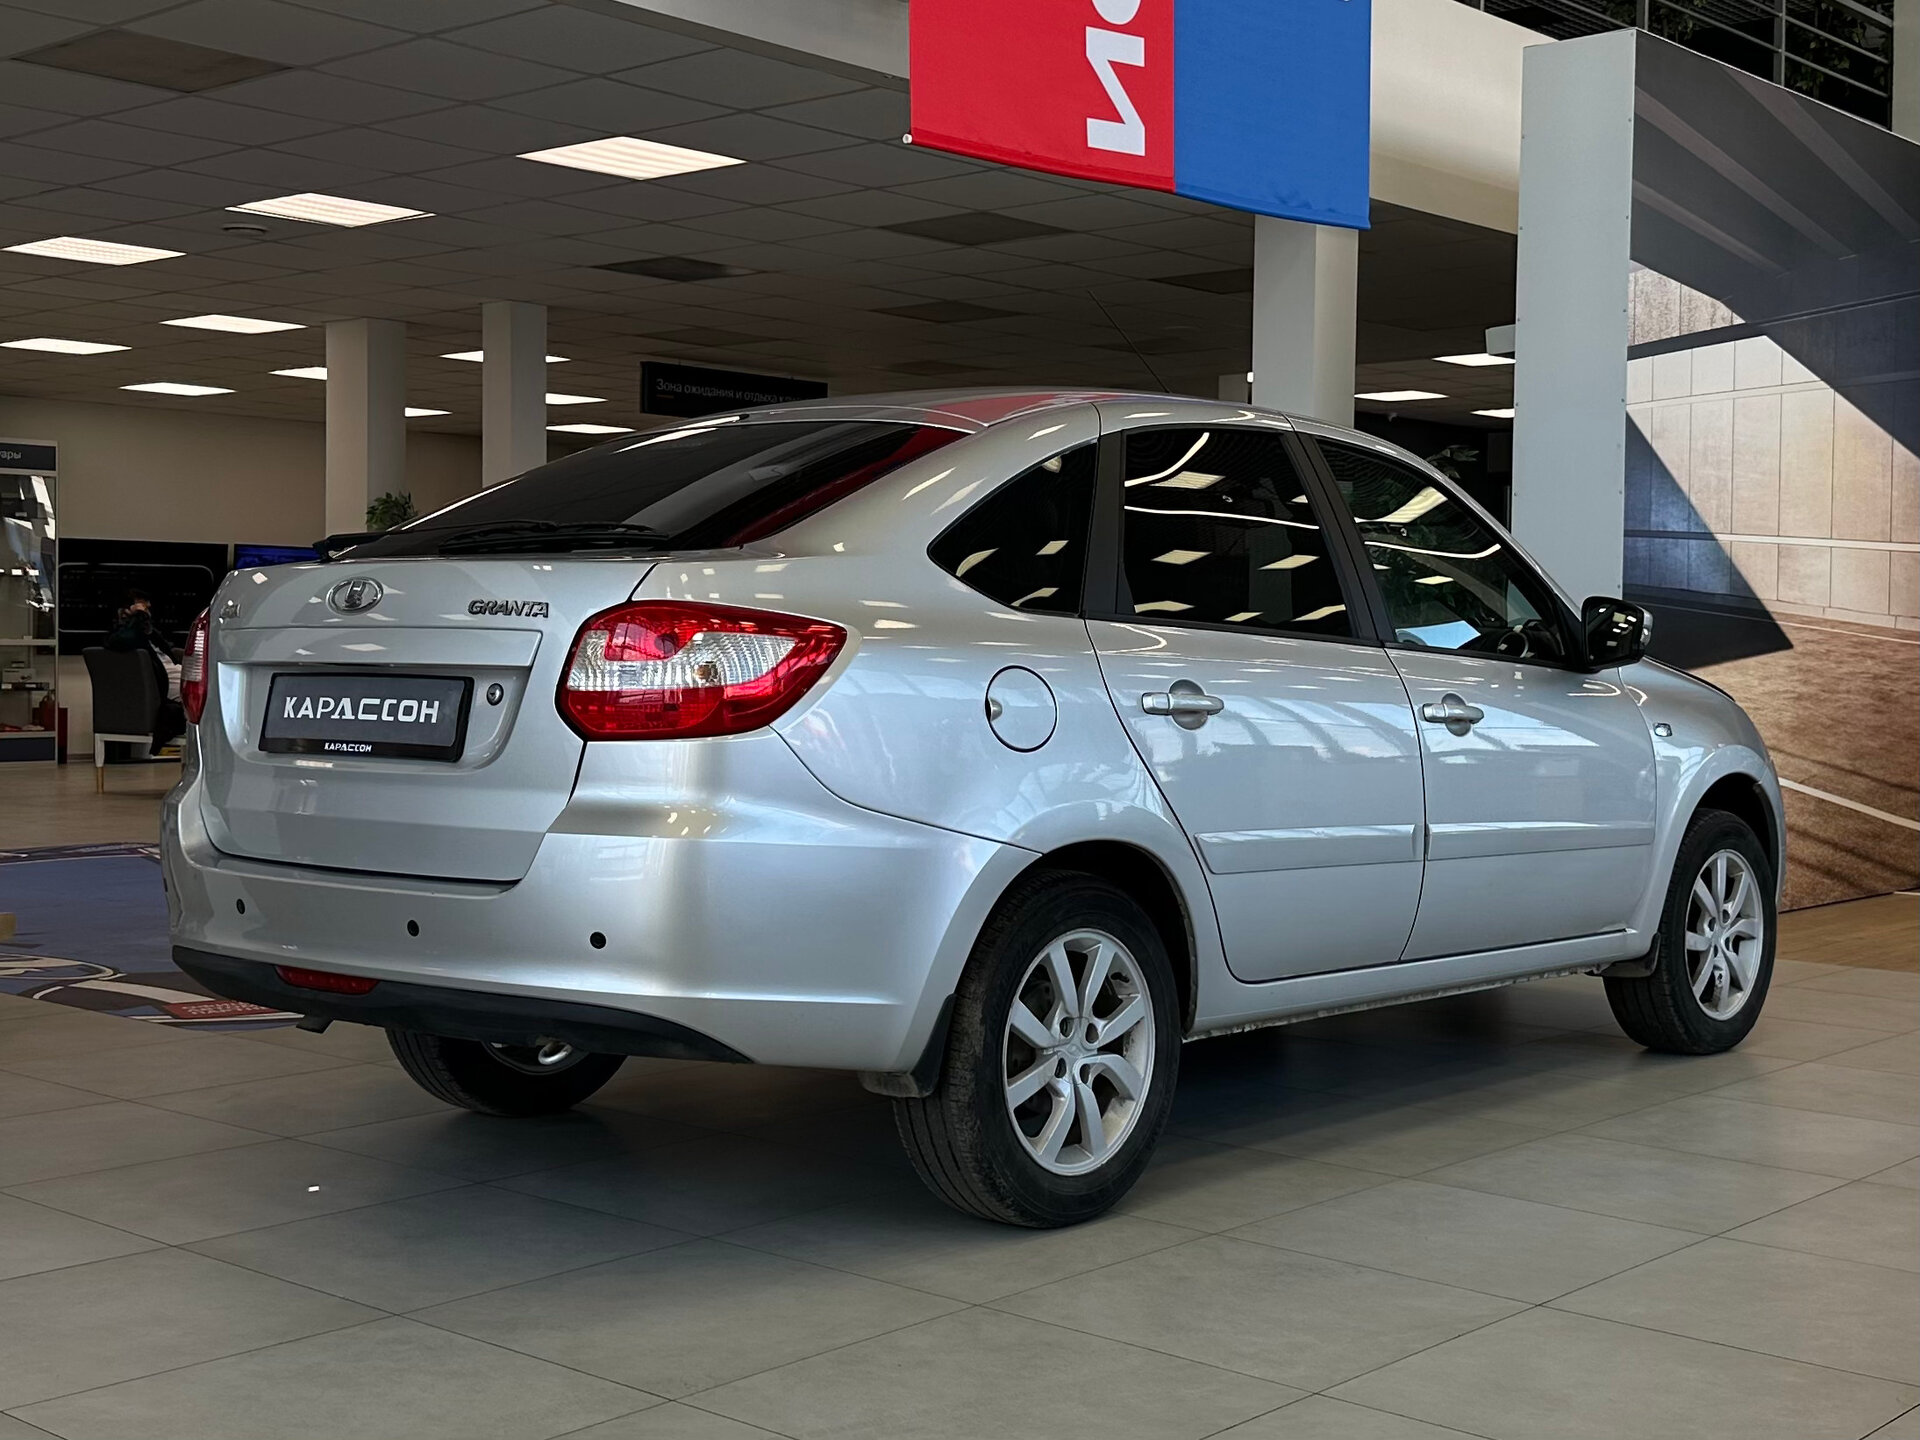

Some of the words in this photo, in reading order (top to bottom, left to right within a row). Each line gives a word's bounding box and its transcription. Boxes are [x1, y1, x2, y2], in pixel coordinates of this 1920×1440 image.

[655, 378, 682, 393] Зона
[684, 384, 734, 399] ожидания
[735, 390, 743, 400] и
[743, 391, 778, 403] отдыха
[0, 449, 22, 460] ары
[468, 599, 549, 618] GRANTA
